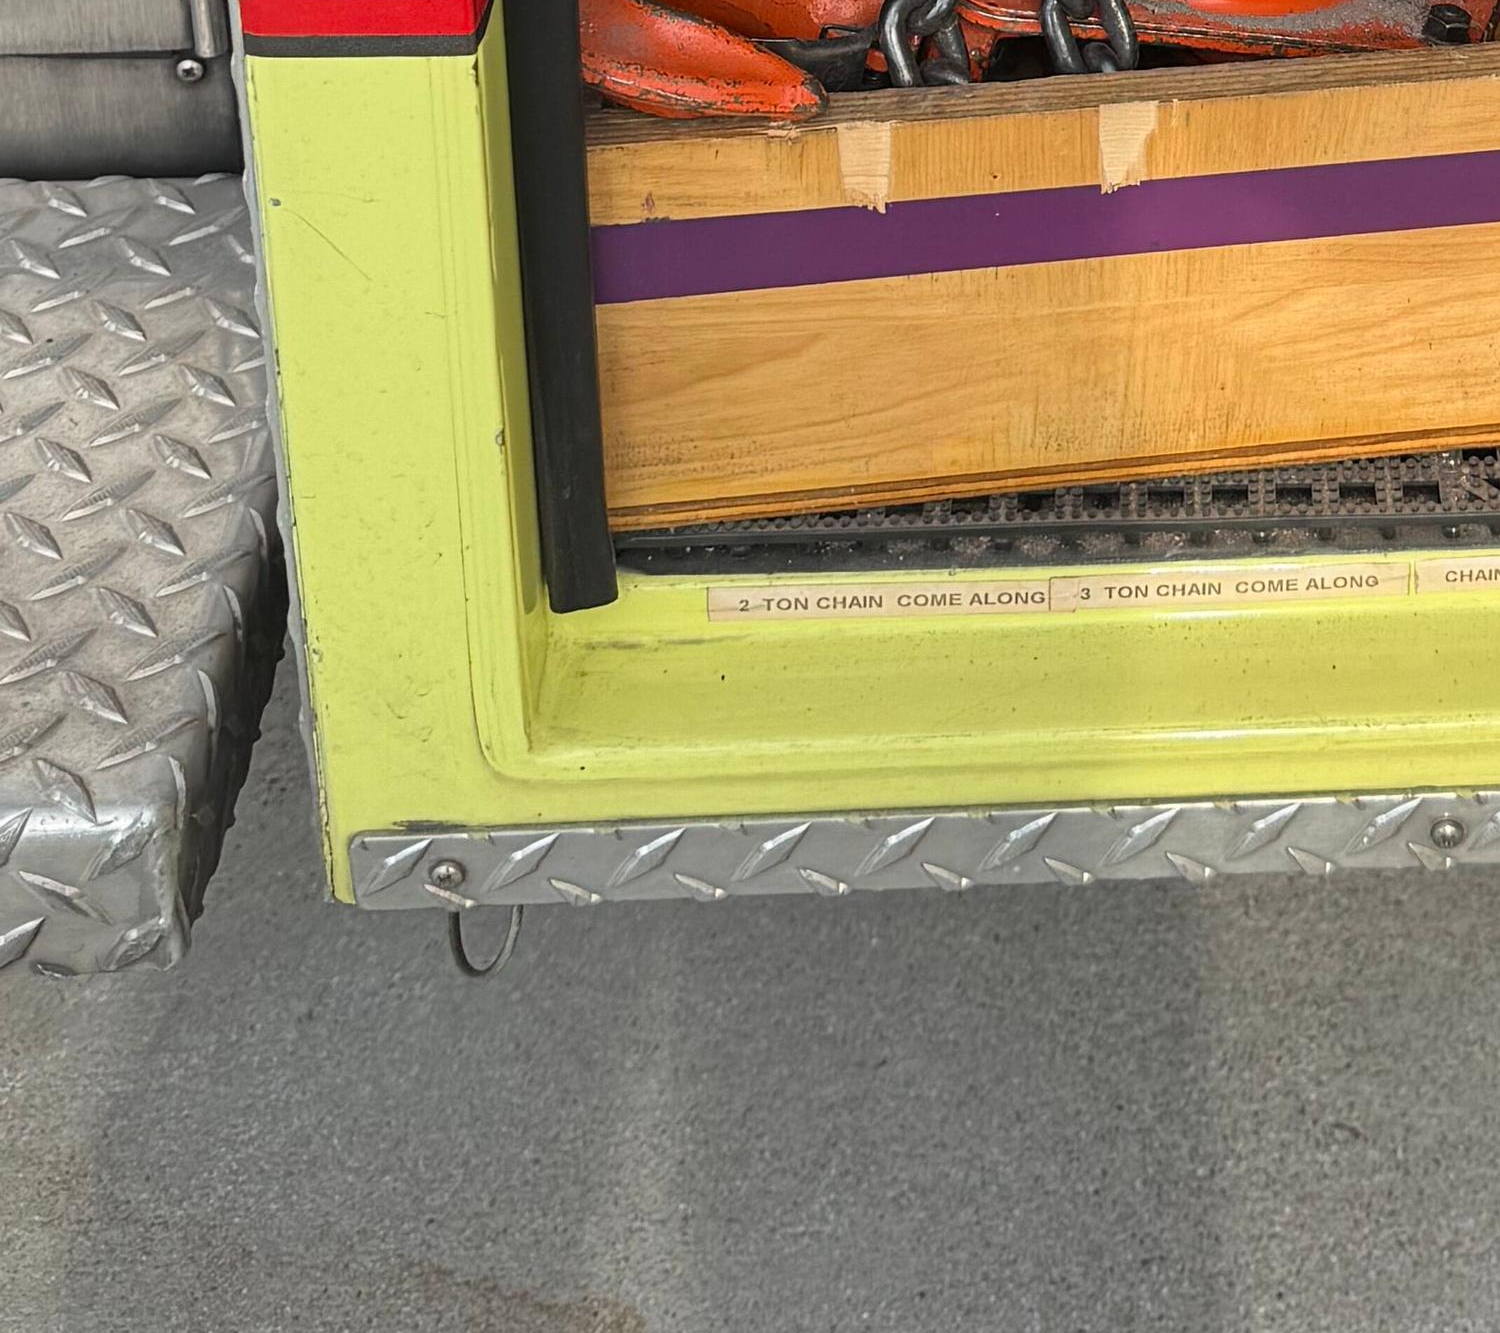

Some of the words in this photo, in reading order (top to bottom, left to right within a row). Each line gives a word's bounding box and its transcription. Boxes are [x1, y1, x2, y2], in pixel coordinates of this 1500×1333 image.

[1080, 587, 1091, 601] 3
[1104, 584, 1149, 599] TON
[1156, 582, 1222, 597] CHAIN
[1235, 578, 1299, 594] COME
[1305, 575, 1379, 591] ALONG
[738, 598, 750, 612] 2
[762, 596, 809, 612] TON
[816, 593, 883, 610] CHAIN
[897, 592, 962, 608] COME
[969, 591, 1047, 606] ALONG
